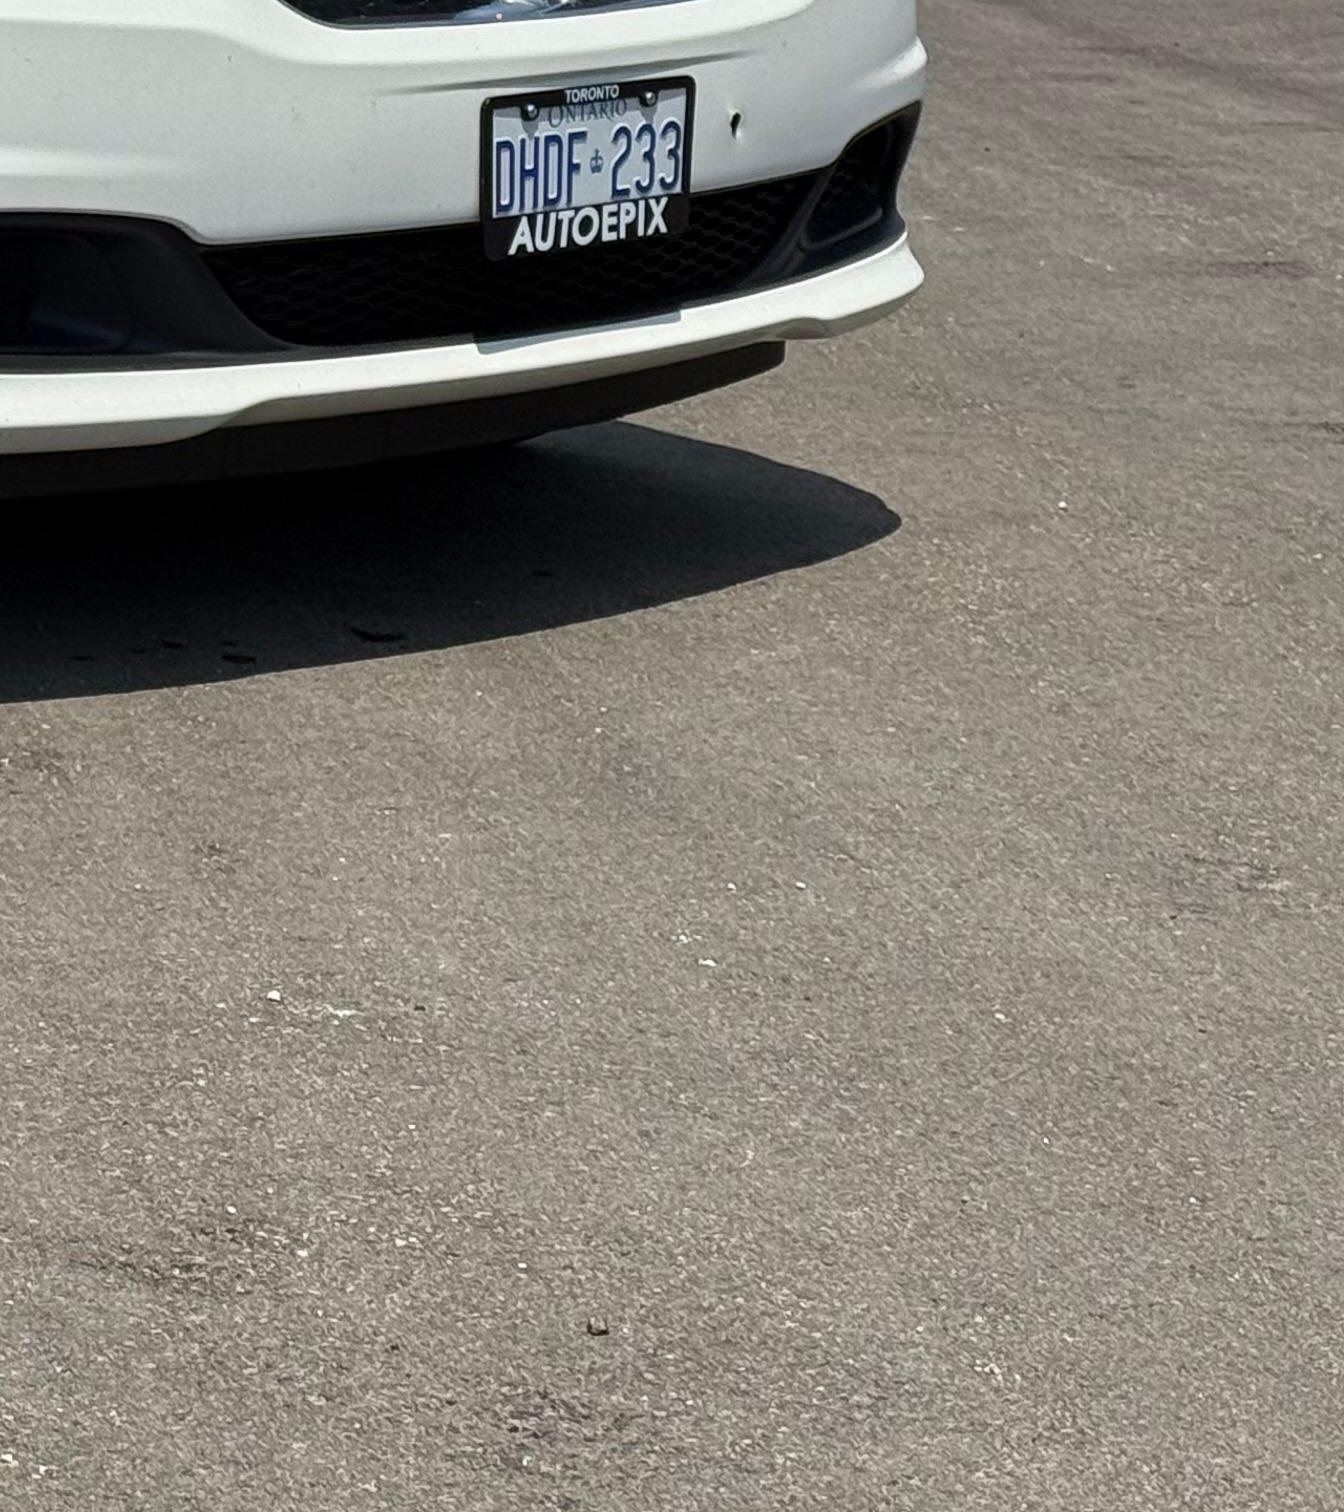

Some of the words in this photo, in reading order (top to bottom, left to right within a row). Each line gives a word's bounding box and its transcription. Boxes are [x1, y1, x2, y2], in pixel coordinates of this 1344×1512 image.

[548, 99, 628, 128] ONTARIO
[564, 84, 620, 104] TORONTO
[495, 130, 588, 213] DHDF
[610, 119, 682, 200] 233
[508, 196, 669, 256] AUTOEPIX
